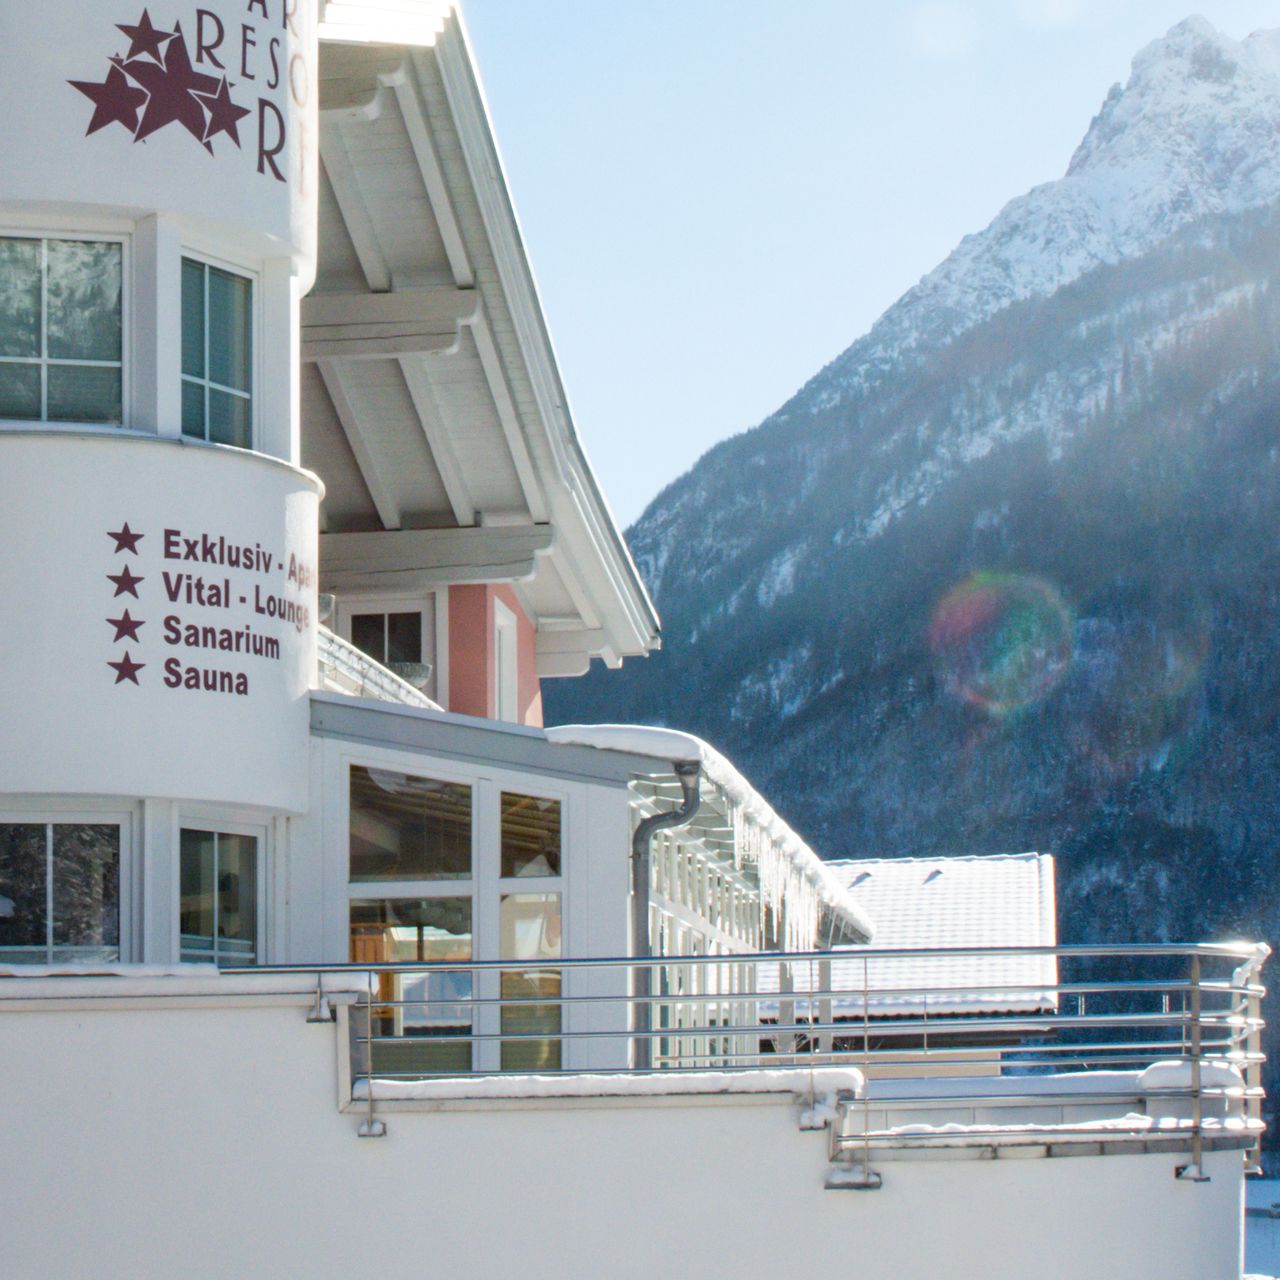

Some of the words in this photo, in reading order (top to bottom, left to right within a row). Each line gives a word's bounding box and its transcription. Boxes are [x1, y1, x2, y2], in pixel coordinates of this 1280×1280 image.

[163, 528, 273, 573] Exklusiv
[162, 571, 230, 609] Vital
[255, 584, 310, 633] Lounge
[163, 615, 280, 660] Sanarium
[163, 657, 249, 696] Sauna
